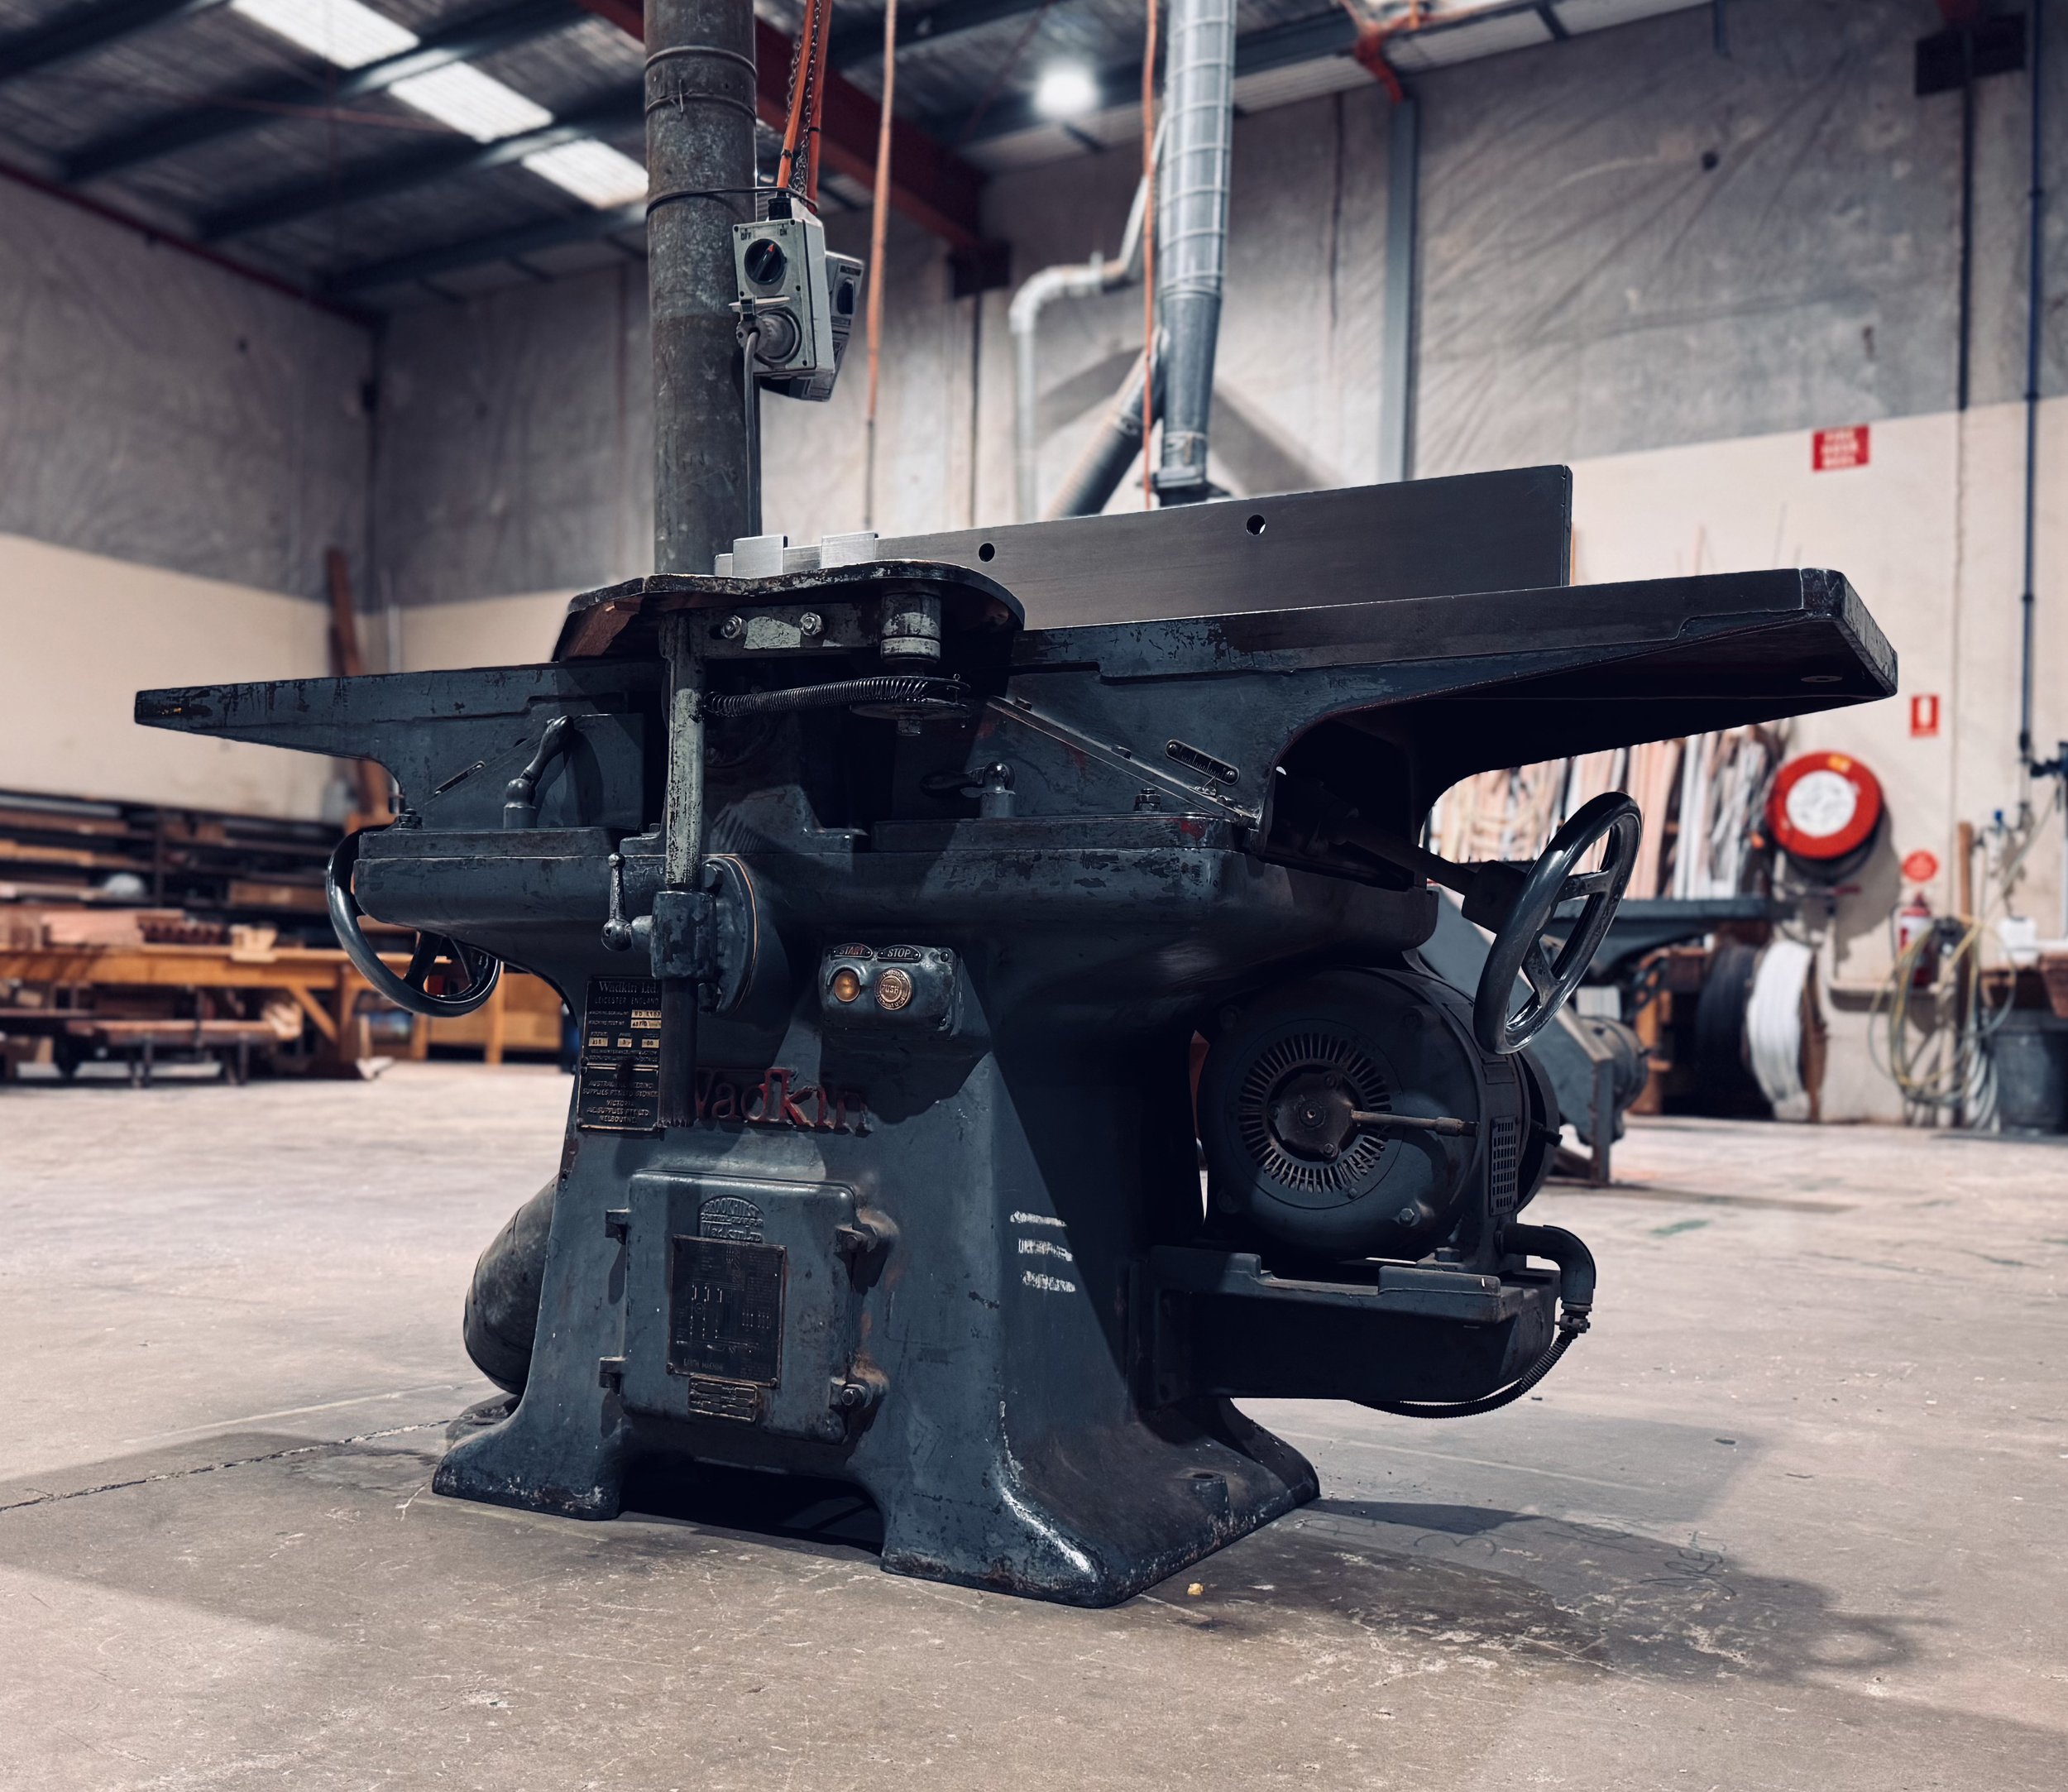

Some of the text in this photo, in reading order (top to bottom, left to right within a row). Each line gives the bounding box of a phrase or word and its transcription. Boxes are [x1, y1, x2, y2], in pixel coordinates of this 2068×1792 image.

[740, 232, 752, 241] OFF
[839, 946, 865, 956] START
[887, 947, 912, 958] STOP
[598, 980, 637, 994] Wadkin
[881, 984, 900, 994] PUSH
[631, 996, 659, 1005] ENGLAND
